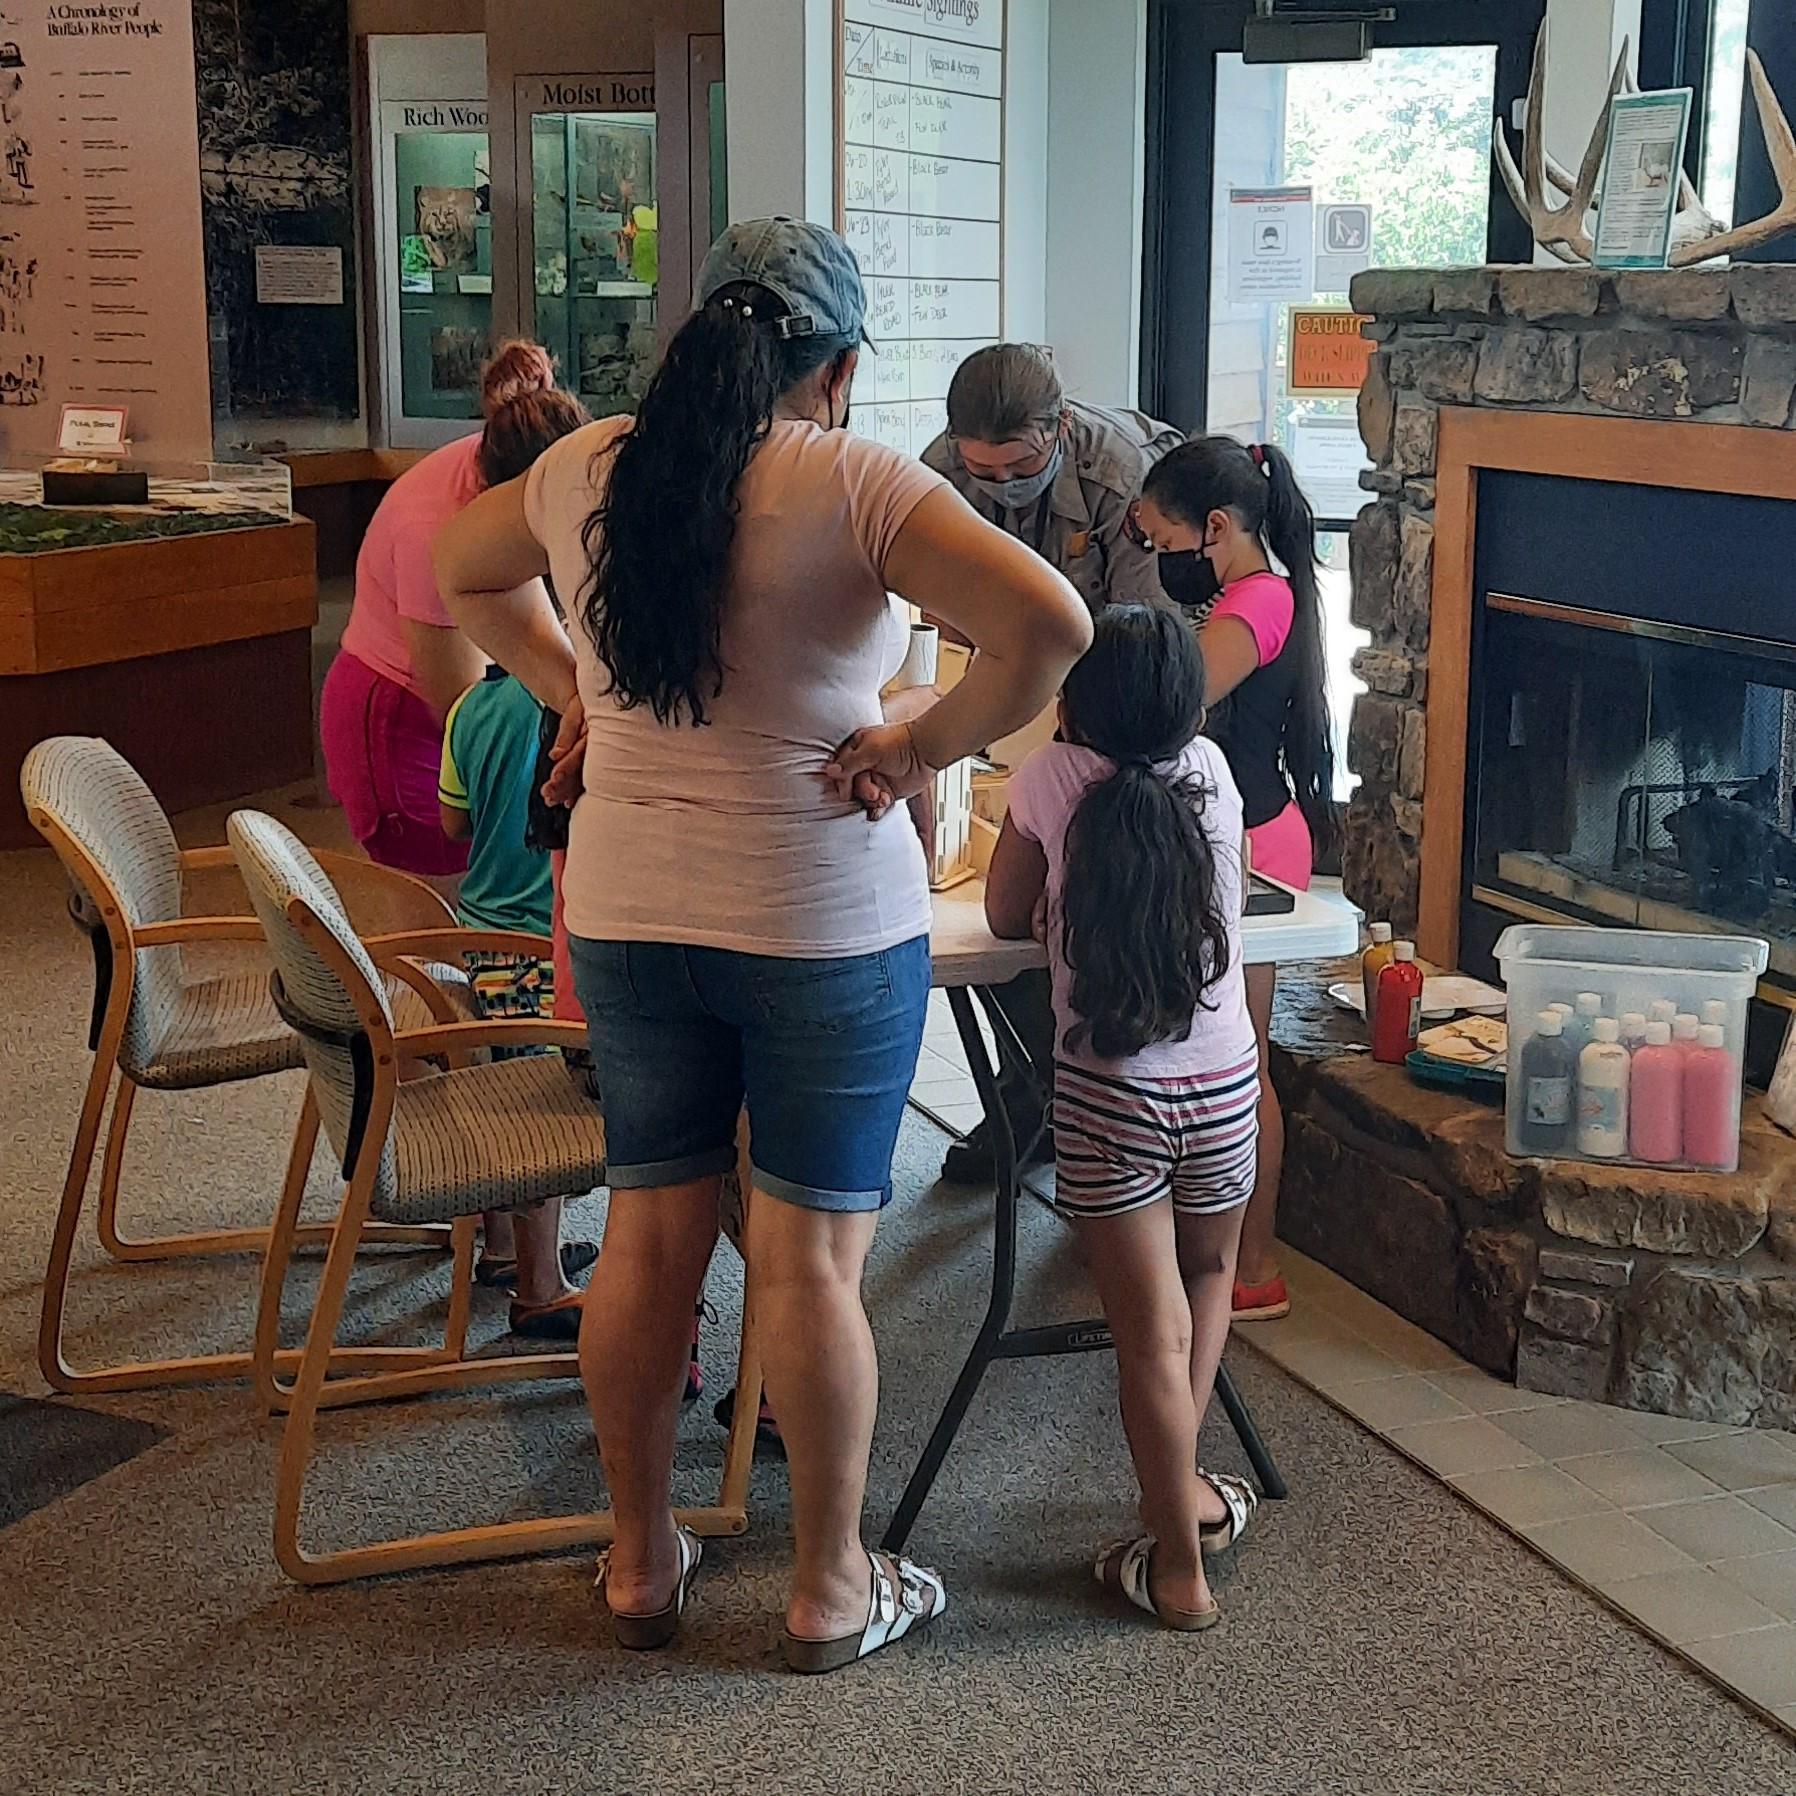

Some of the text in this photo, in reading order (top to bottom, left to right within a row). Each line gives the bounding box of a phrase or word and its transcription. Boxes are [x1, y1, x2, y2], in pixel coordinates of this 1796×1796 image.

[47, 2, 140, 21] A Chronology of
[926, 0, 980, 26] Sightings
[48, 19, 162, 38] Buffalo River People
[543, 83, 602, 105] Moist
[403, 107, 444, 126] Rich
[1297, 315, 1375, 335] CAUTI
